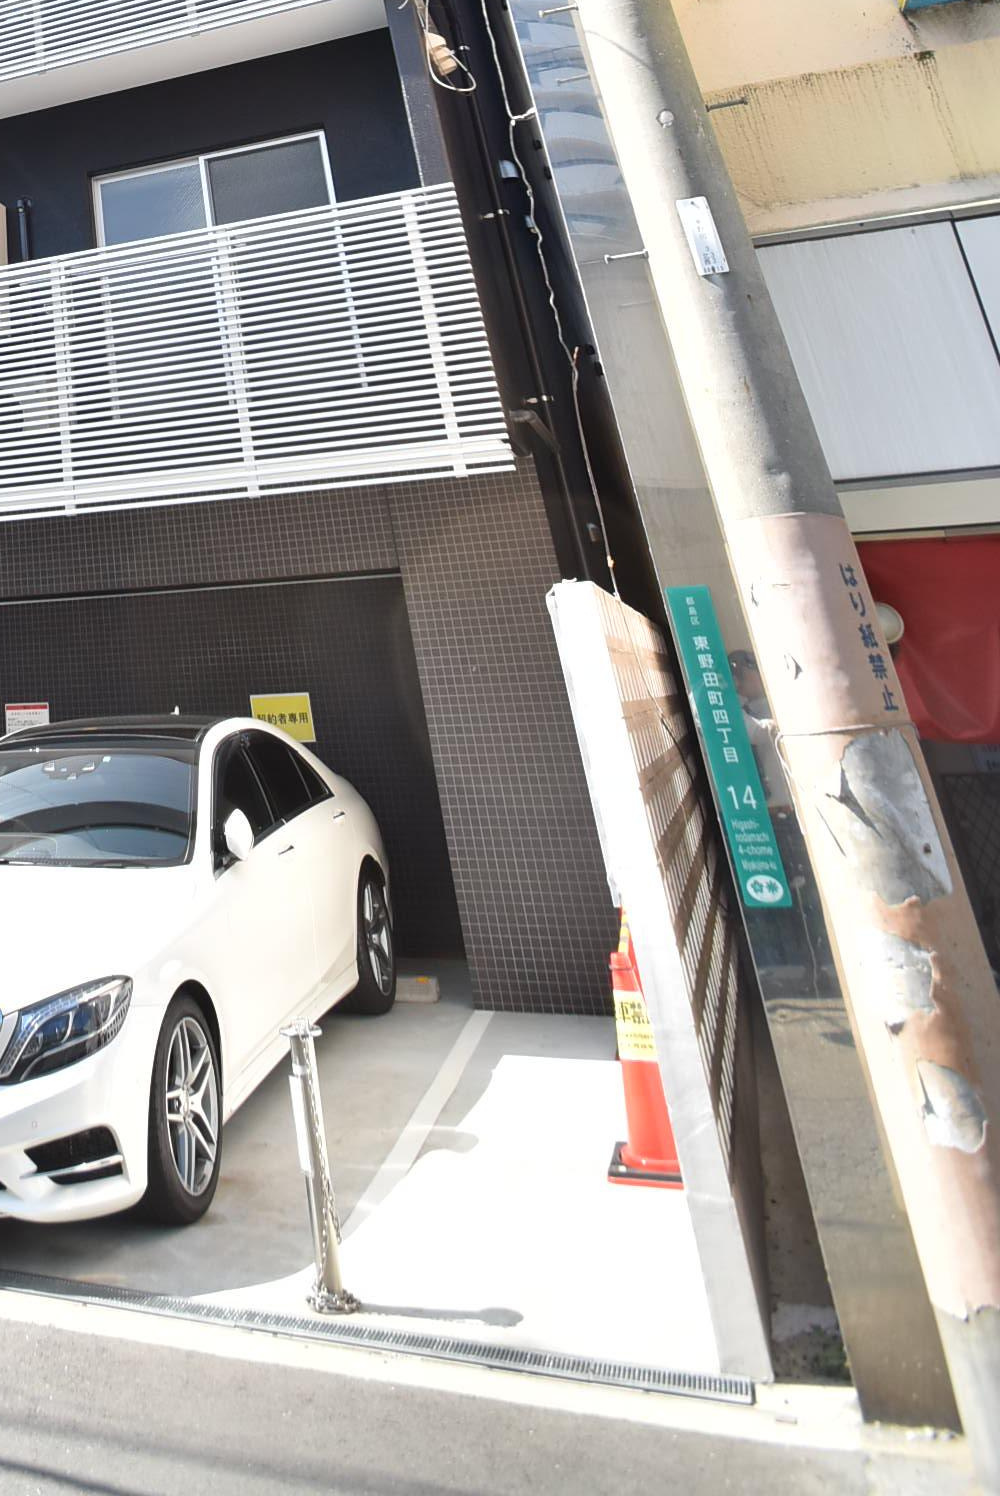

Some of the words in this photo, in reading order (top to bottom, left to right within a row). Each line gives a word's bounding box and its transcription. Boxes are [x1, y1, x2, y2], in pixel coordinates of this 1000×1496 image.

[692, 635, 739, 764] 東野田町四丁目
[838, 562, 899, 712] はり紙禁止
[726, 784, 757, 811] 14
